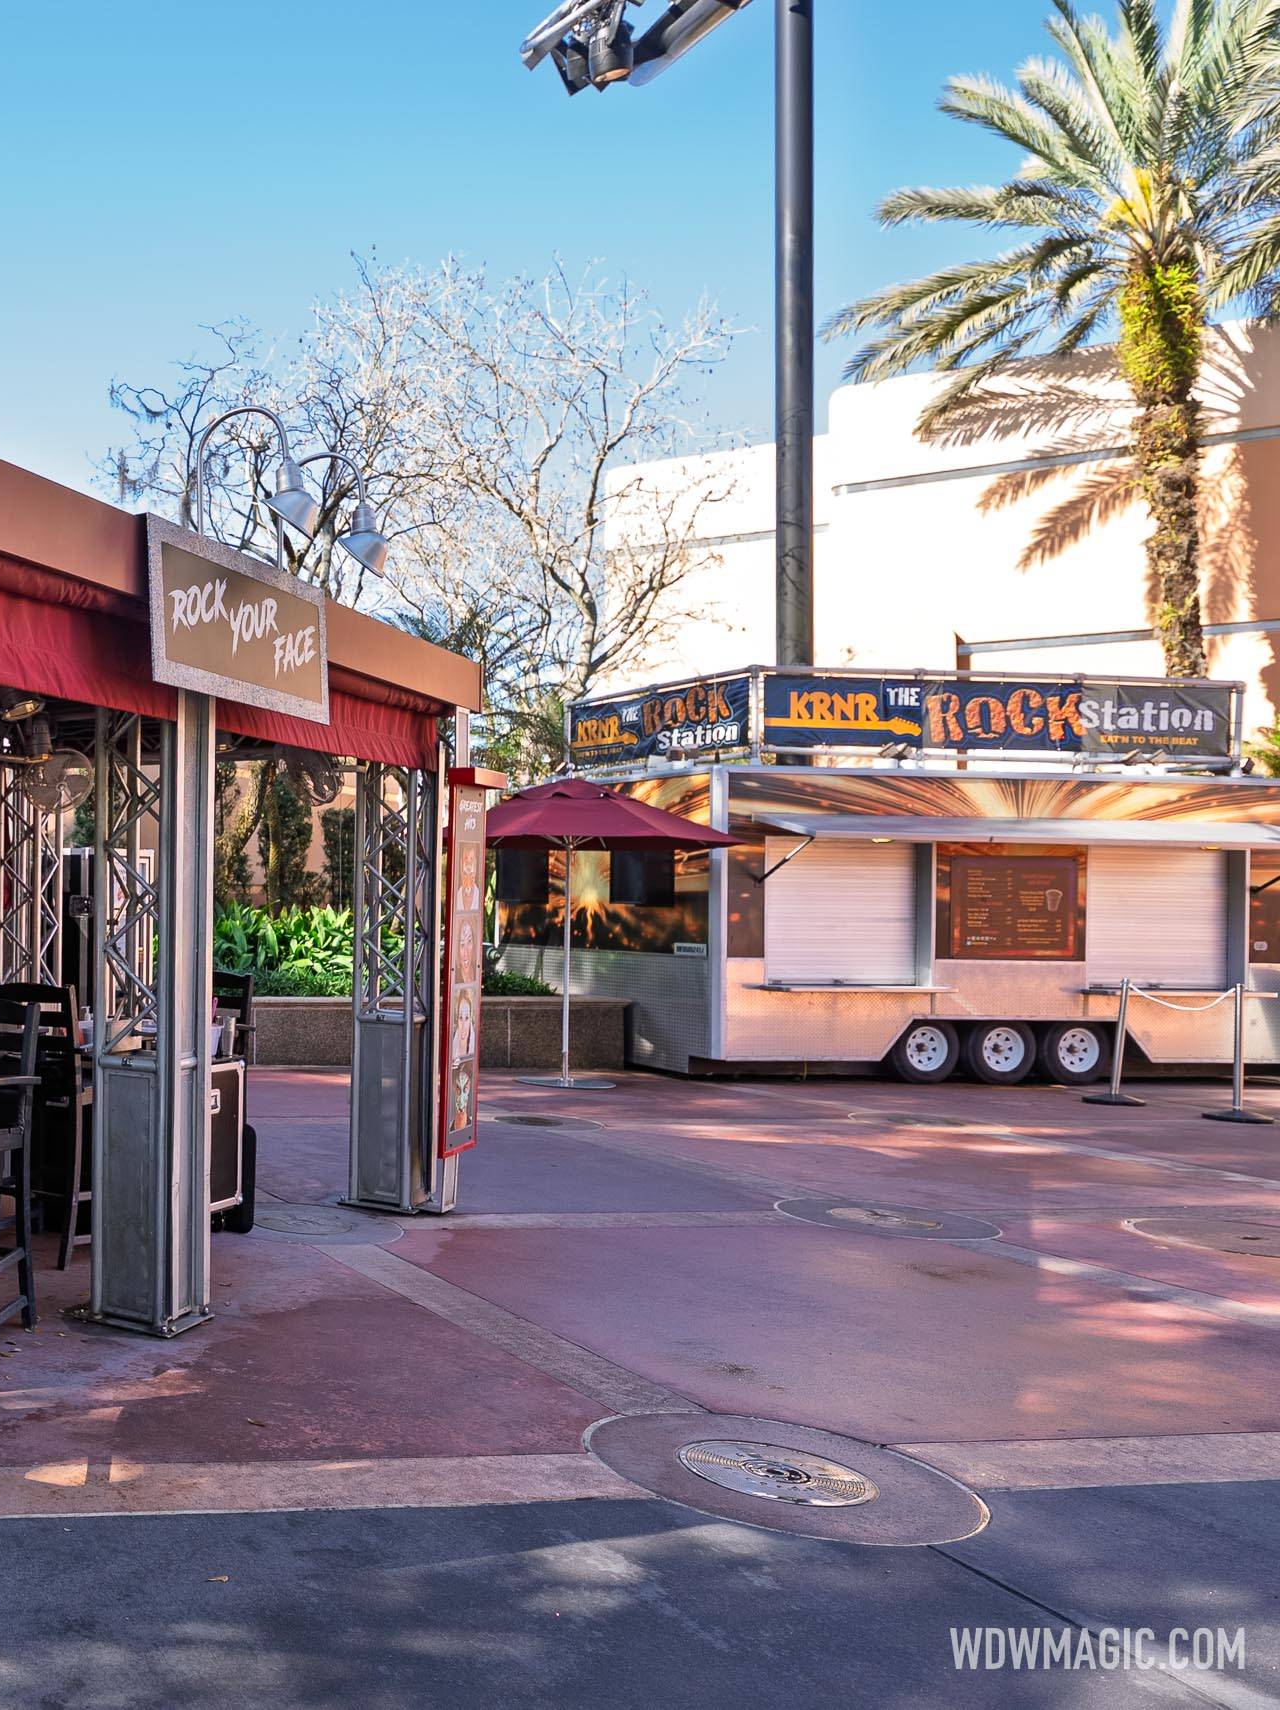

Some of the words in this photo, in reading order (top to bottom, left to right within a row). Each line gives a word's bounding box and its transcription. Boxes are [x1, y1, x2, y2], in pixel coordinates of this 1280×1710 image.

[168, 577, 229, 635] ROCK
[229, 597, 280, 660] YOUR
[273, 625, 317, 680] FACE
[621, 706, 641, 723] THE
[641, 683, 732, 736] ROCK
[788, 690, 880, 722] KRNR
[886, 687, 921, 707] THE
[925, 688, 1087, 743] ROCK
[1078, 699, 1215, 733] Station
[577, 714, 621, 743] KRNR
[657, 723, 739, 750] Station
[1132, 735, 1146, 744] TO
[1148, 736, 1169, 745] THE
[1170, 736, 1199, 746] BEAT
